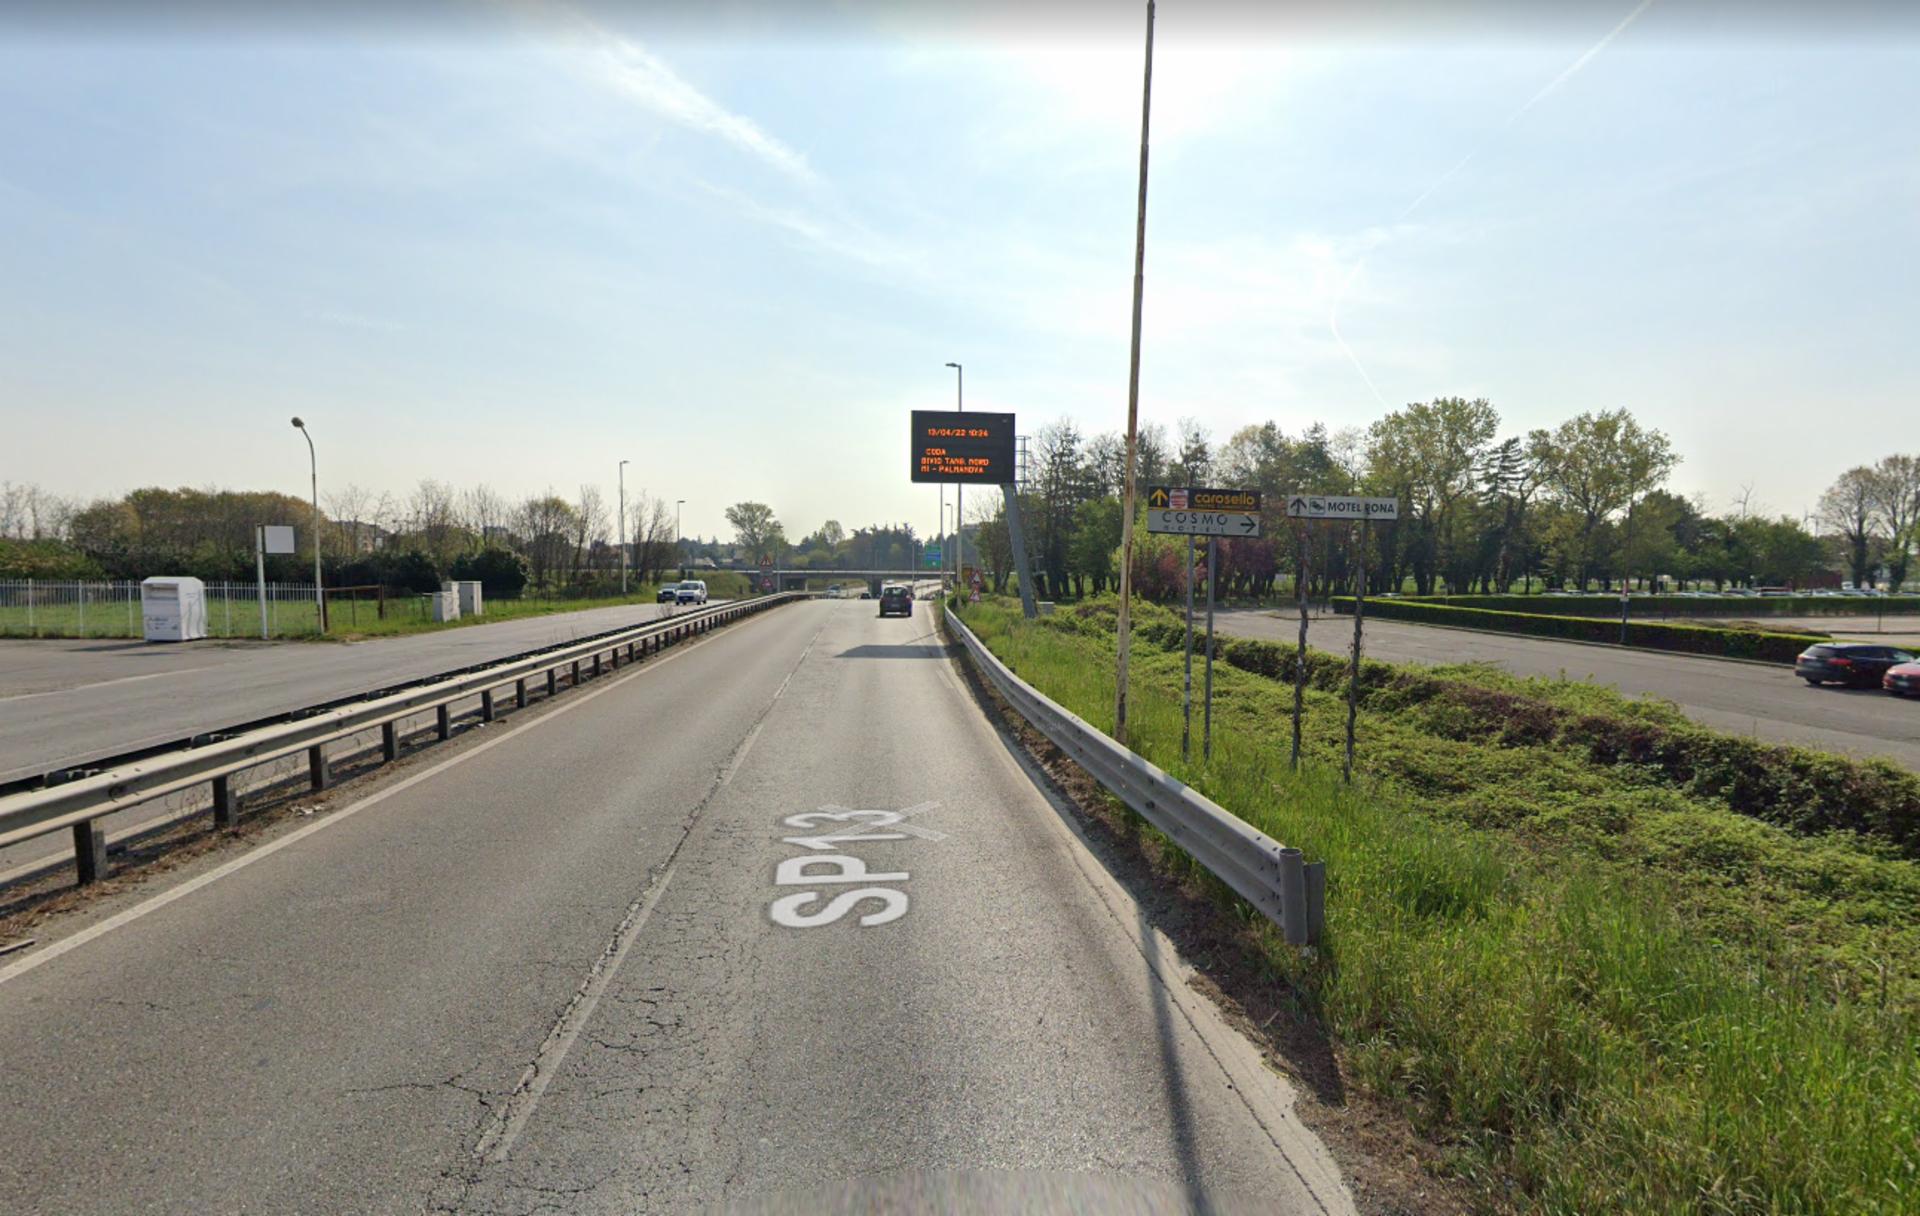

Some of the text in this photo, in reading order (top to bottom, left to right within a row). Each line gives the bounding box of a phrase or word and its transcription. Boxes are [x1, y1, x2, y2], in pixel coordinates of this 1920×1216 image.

[939, 466, 984, 474] PALMANOVA
[1194, 492, 1256, 505] carosello
[1328, 502, 1362, 513] MOTEL
[1162, 512, 1229, 526] COSMO
